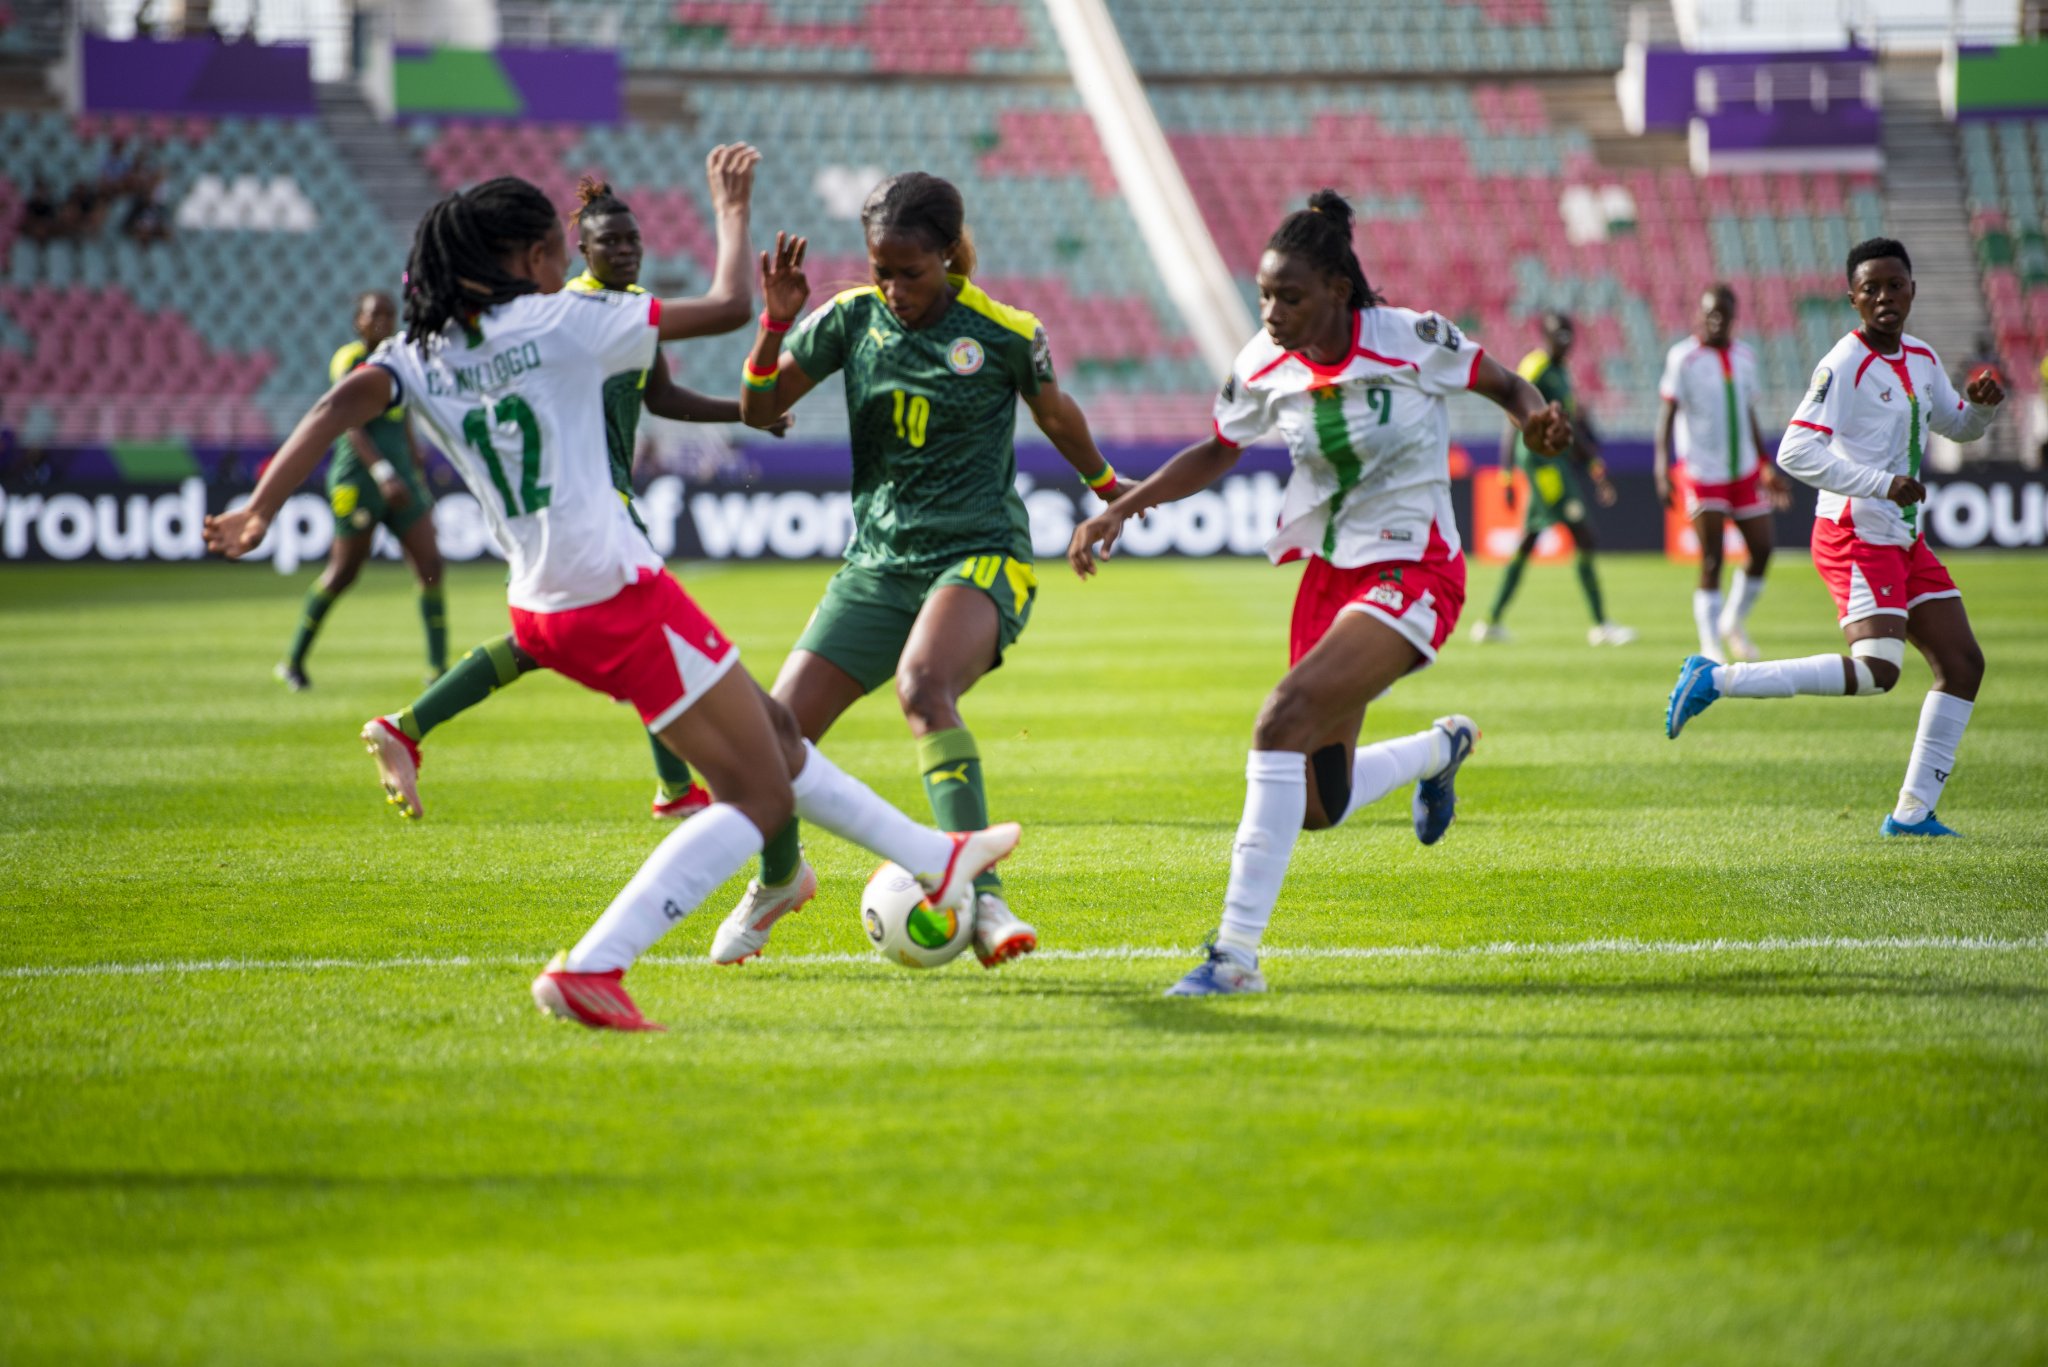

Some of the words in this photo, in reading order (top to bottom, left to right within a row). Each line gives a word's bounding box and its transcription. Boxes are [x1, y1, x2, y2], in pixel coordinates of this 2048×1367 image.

[892, 388, 930, 448] 10
[1367, 387, 1392, 426] 9
[463, 393, 552, 518] 12
[0, 476, 207, 560] roud
[960, 555, 1002, 590] 10
